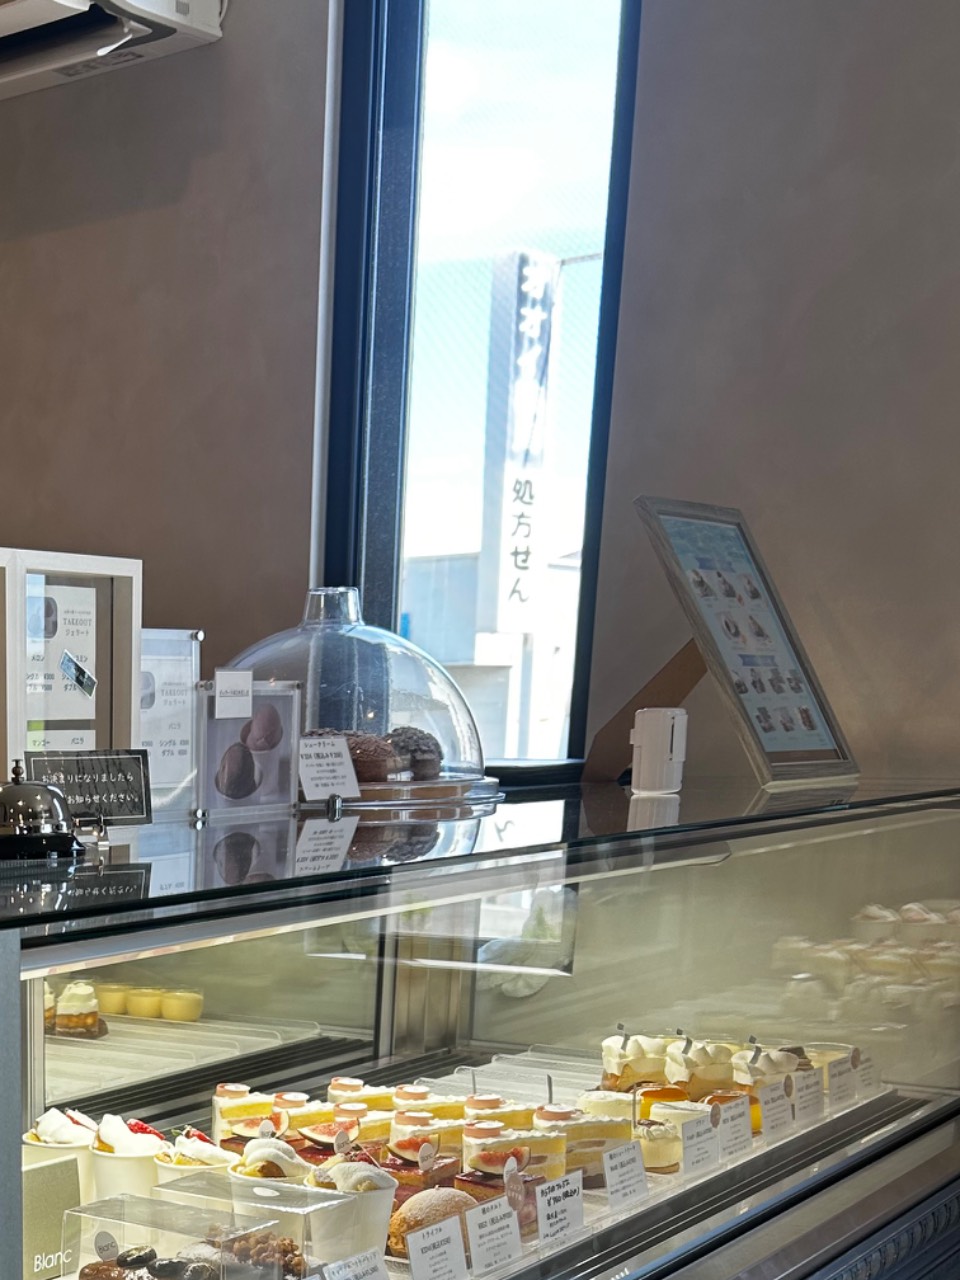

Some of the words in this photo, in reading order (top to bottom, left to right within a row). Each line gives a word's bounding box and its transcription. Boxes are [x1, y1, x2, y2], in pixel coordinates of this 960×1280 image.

[509, 478, 535, 603] 処方せん
[63, 618, 92, 626] TAKEOUT
[65, 629, 89, 637] ジェラート
[42, 771, 134, 783] お決まりになりましたら
[65, 793, 139, 804] お知らせください。
[33, 1248, 73, 1273] Blanc
